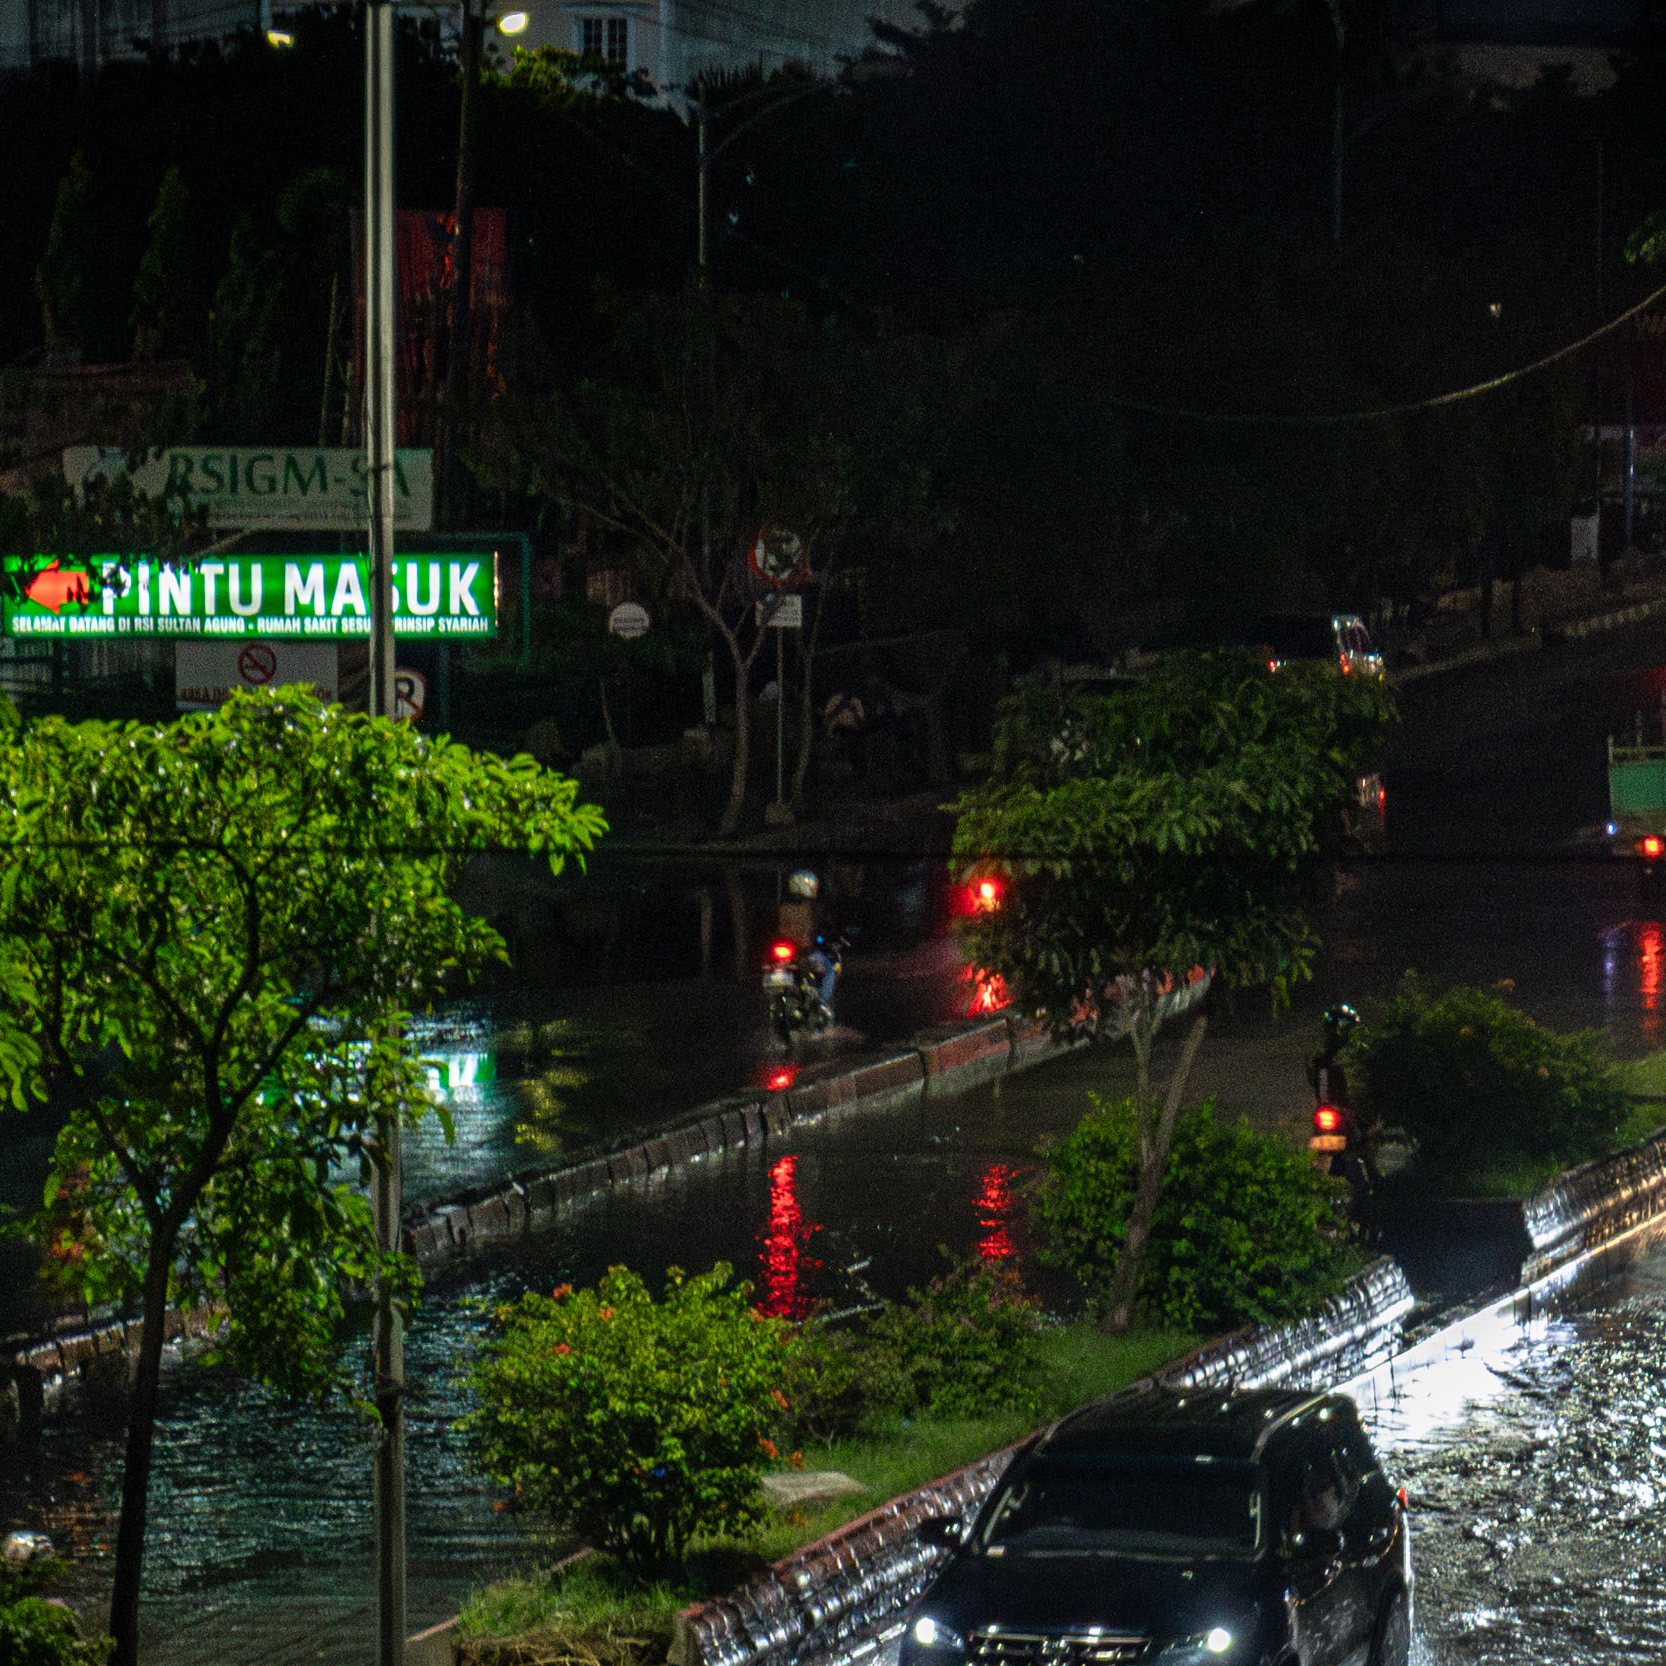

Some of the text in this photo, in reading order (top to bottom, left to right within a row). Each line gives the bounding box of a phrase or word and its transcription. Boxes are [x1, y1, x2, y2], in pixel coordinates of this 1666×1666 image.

[102, 561, 263, 616] PINTU
[12, 616, 488, 632] SELAMAT DATANG DI RSI SULTAN AGUNG RUMAH SAKIT SESU RINSIP SYARIAH
